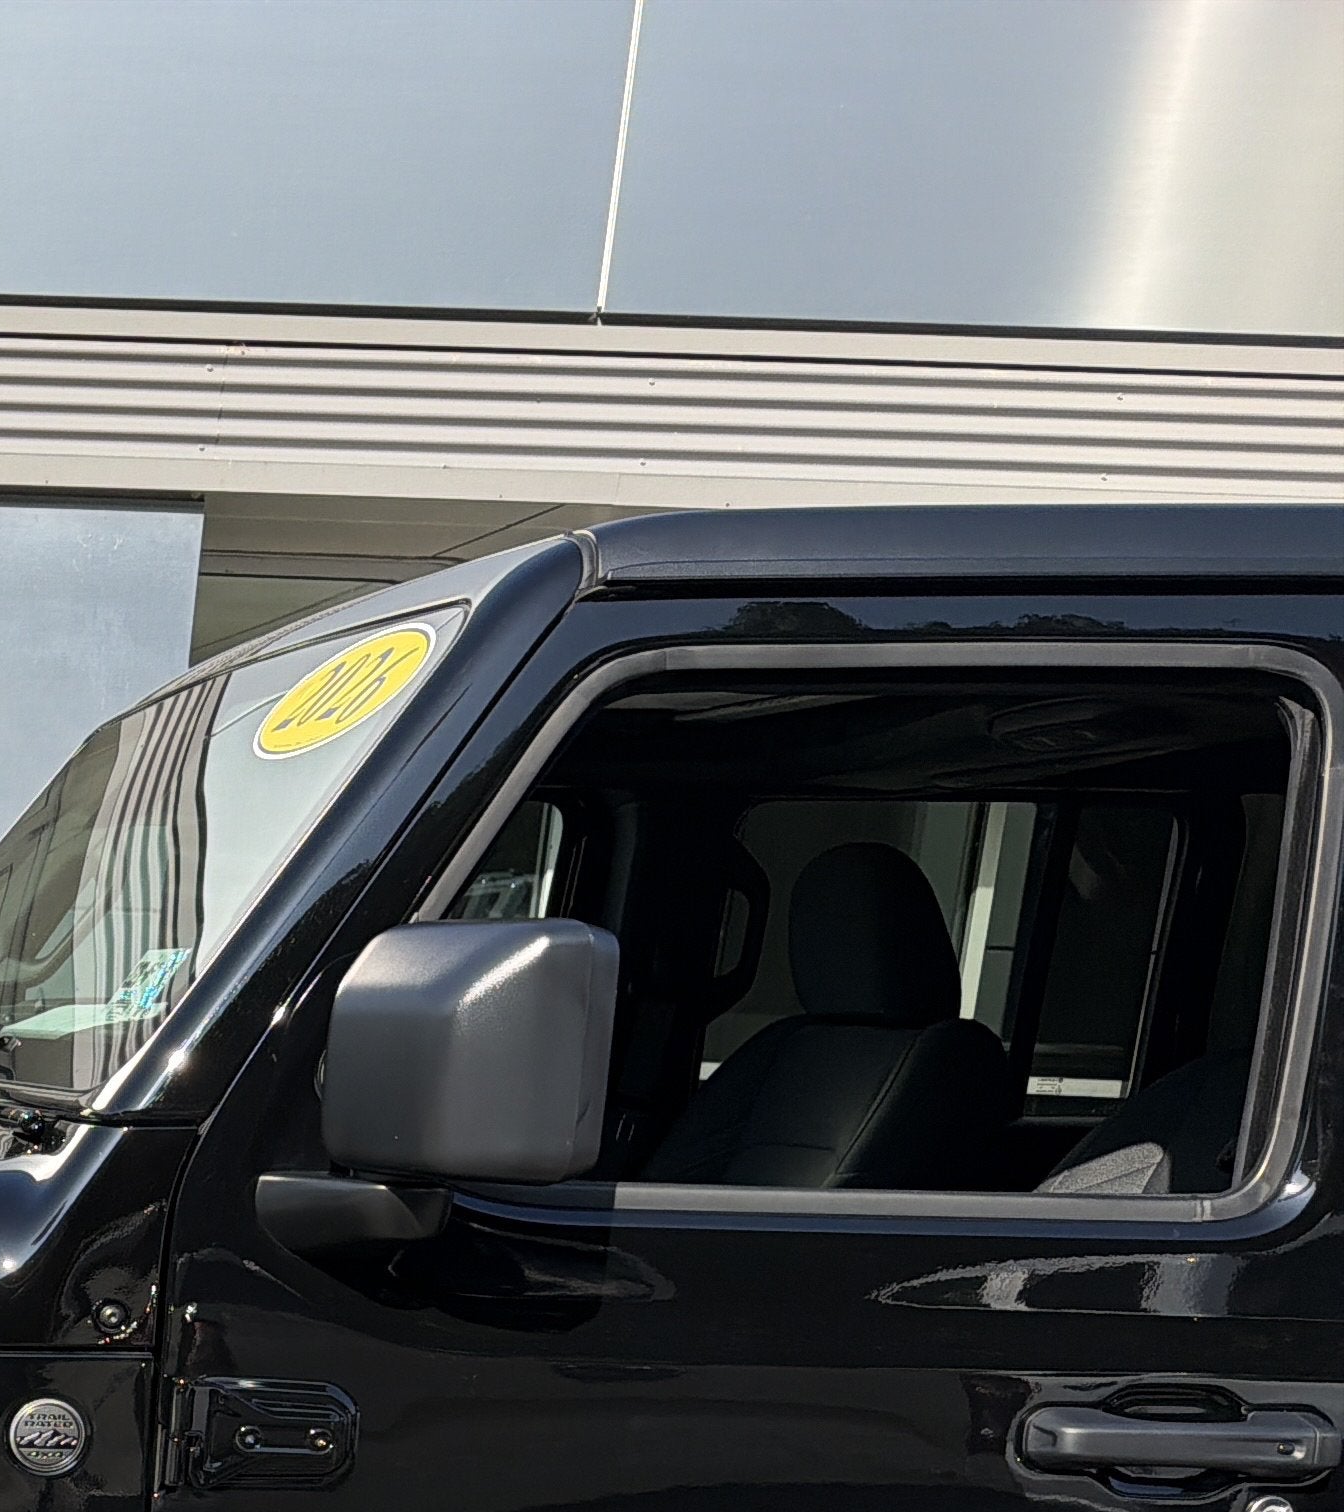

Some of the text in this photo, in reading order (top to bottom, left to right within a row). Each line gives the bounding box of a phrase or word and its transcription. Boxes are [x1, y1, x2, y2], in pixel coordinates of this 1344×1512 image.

[271, 646, 420, 733] 2026
[29, 1413, 70, 1421] TRAIL
[24, 1421, 73, 1429] RATED
